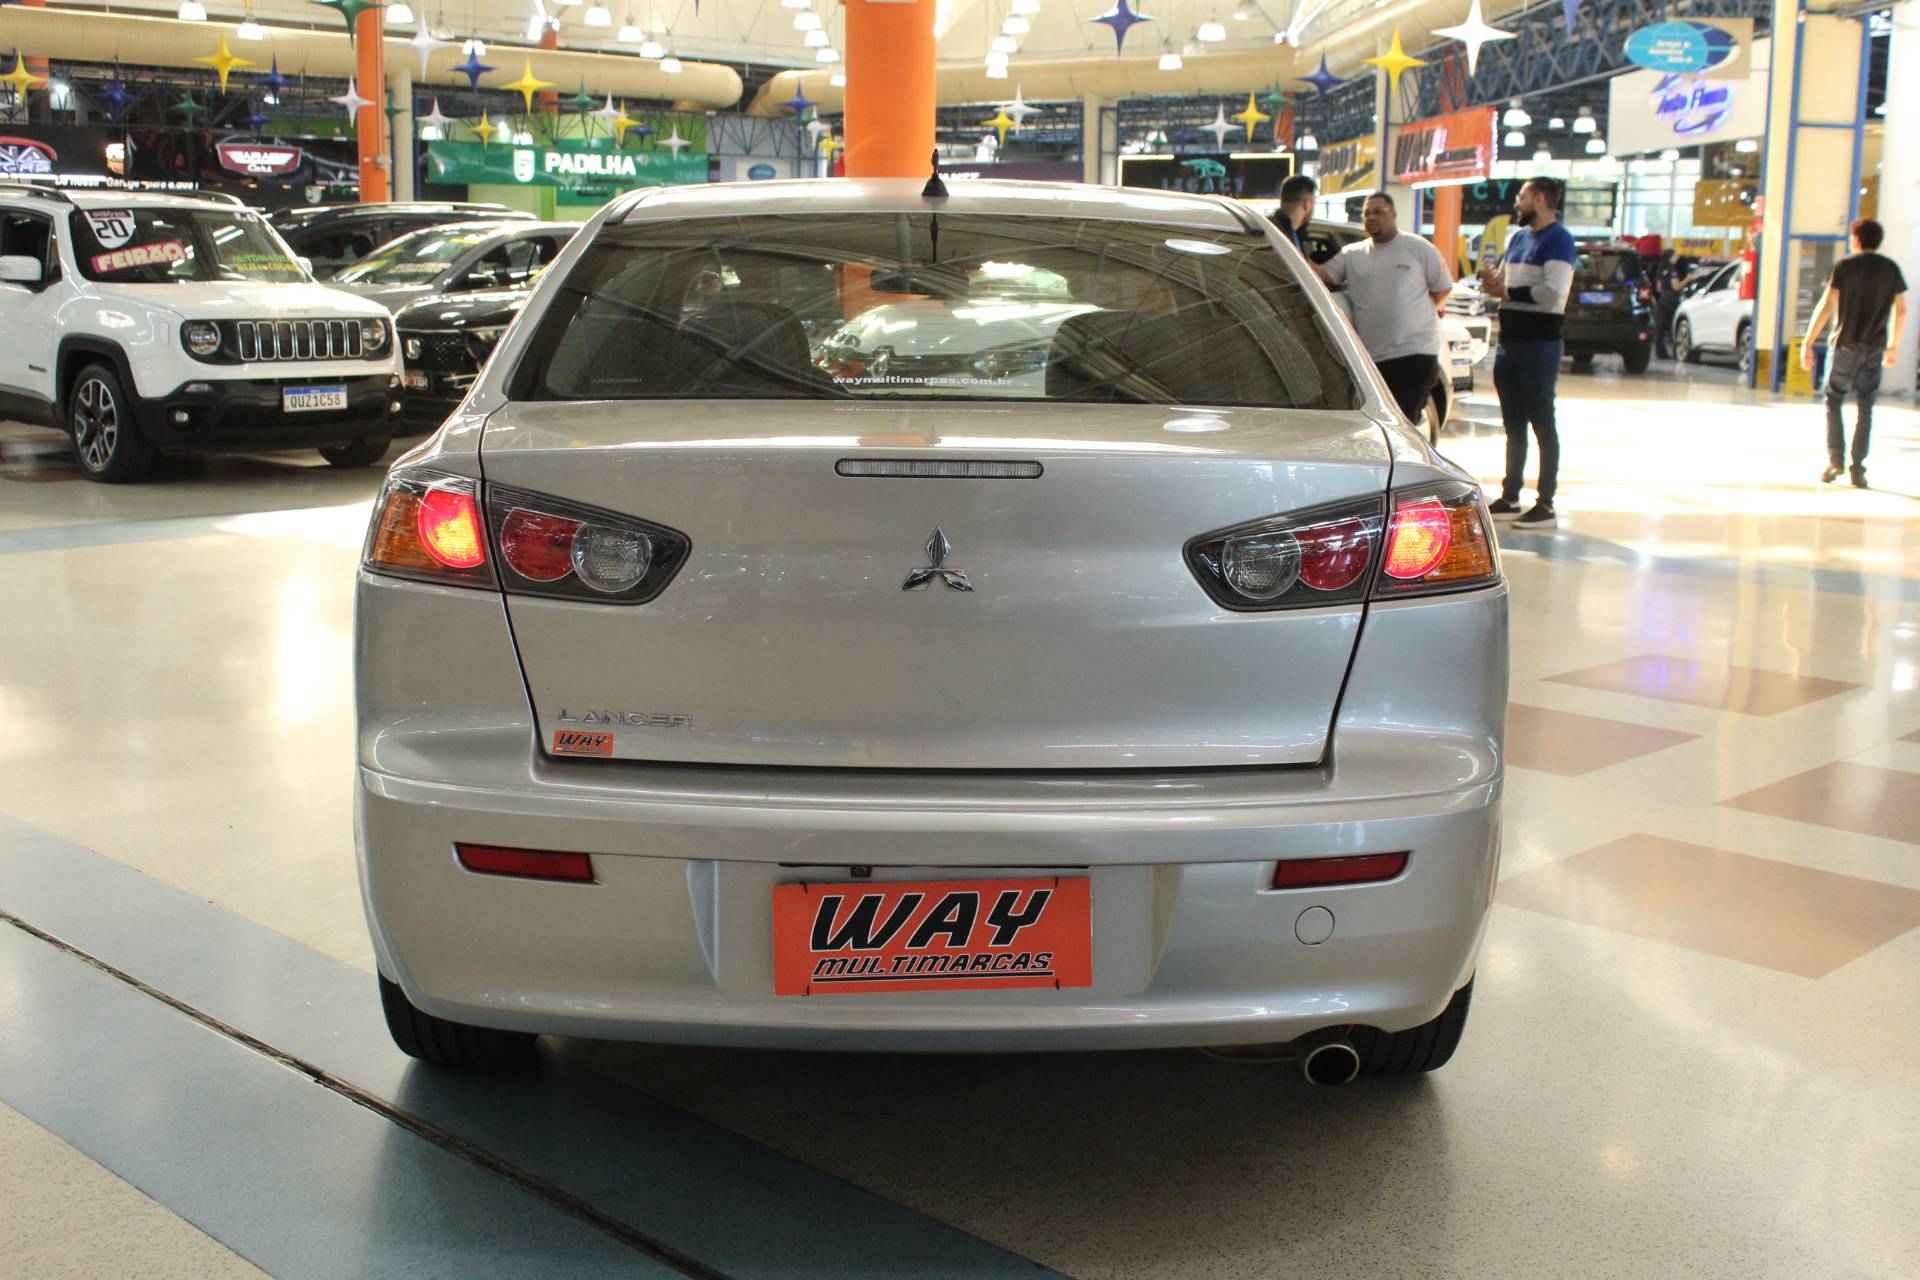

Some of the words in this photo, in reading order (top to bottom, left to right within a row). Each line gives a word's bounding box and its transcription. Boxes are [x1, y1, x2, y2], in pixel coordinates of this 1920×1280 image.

[545, 151, 637, 176] PADILHA
[1161, 176, 1245, 193] LEGACY
[94, 219, 130, 239] 20
[97, 242, 183, 271] FEIRÃO
[832, 375, 1013, 386] waymultimarcas.com.br
[290, 394, 341, 409] QUZ1C58
[558, 708, 693, 729] LANCER
[559, 733, 606, 747] WAY
[810, 889, 1053, 952] WAY
[812, 952, 1054, 977] MULTIMARCAS
